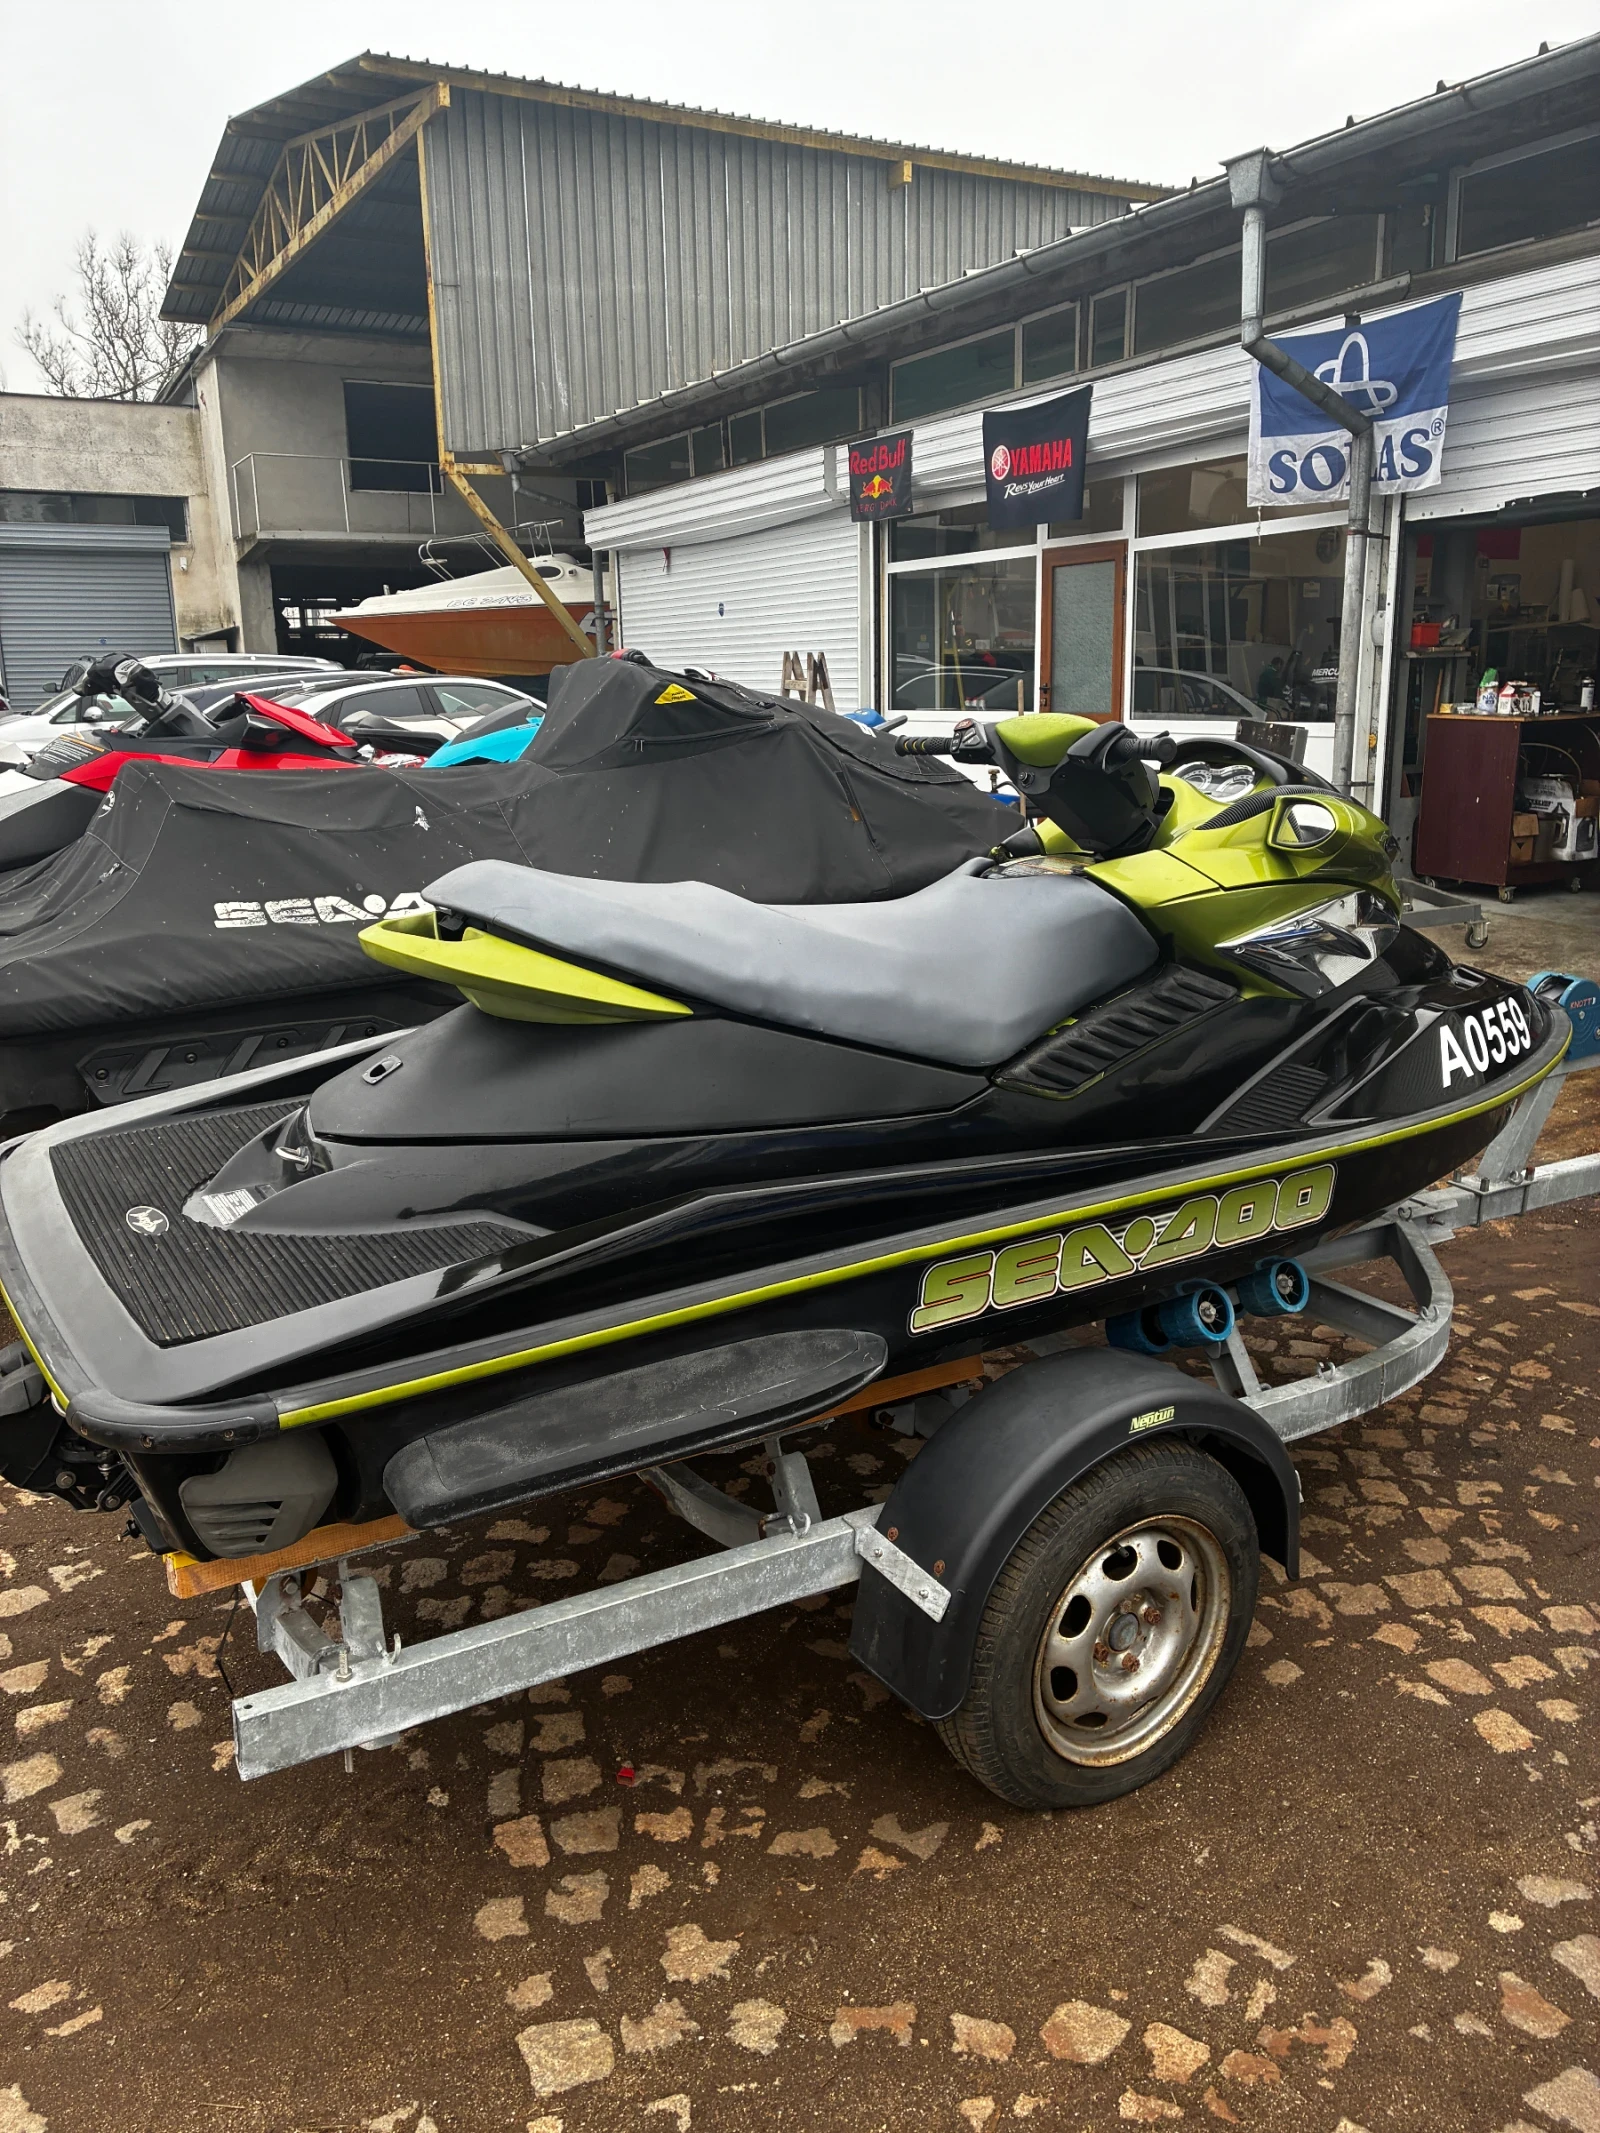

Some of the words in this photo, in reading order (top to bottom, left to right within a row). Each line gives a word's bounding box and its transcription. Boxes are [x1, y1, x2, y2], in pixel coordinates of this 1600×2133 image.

[850, 446, 878, 474] Red
[879, 439, 906, 470] Bull
[1010, 438, 1072, 477] YAMAHA
[1268, 417, 1445, 494] SOAS®
[1004, 482, 1029, 499] Revs
[1028, 480, 1046, 494] Your
[1045, 473, 1066, 488] Heart
[1570, 997, 1593, 1009] KNOTT
[1439, 996, 1532, 1088] A0559
[1130, 1407, 1175, 1432] Neptun
